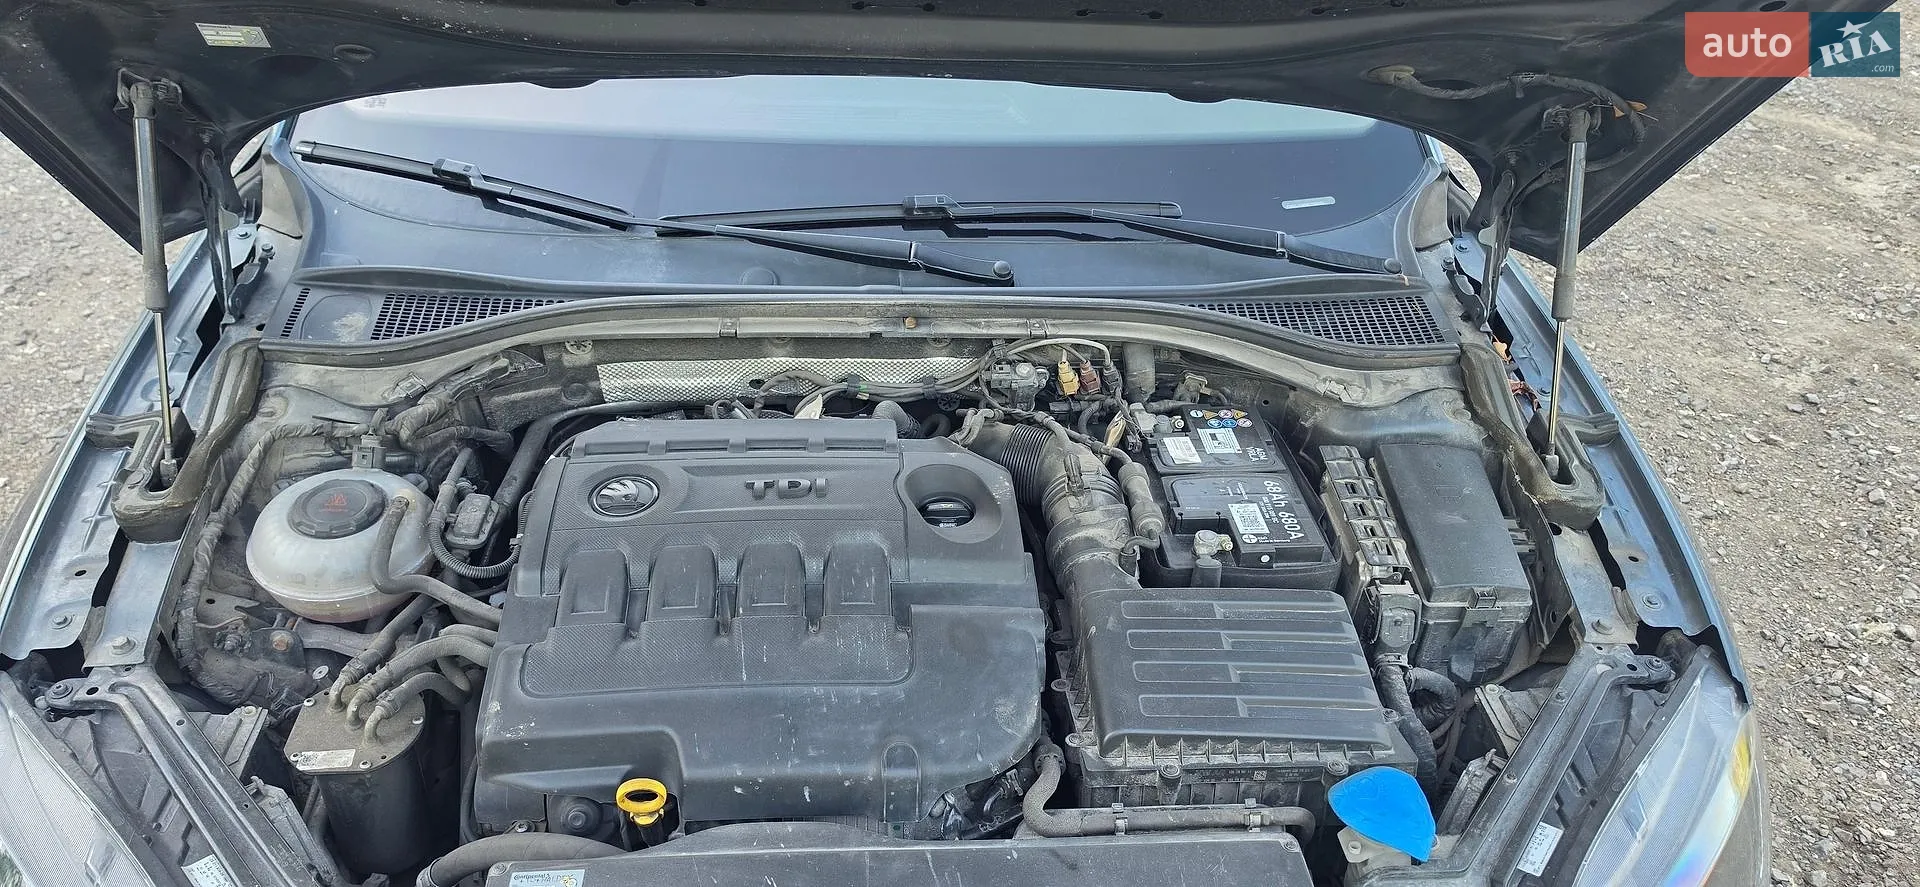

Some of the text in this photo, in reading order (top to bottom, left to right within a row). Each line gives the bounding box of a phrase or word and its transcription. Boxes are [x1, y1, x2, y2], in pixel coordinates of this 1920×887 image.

[744, 478, 829, 499] TDI
[1263, 480, 1289, 508] 68Ah
[1278, 511, 1305, 540] 680A
